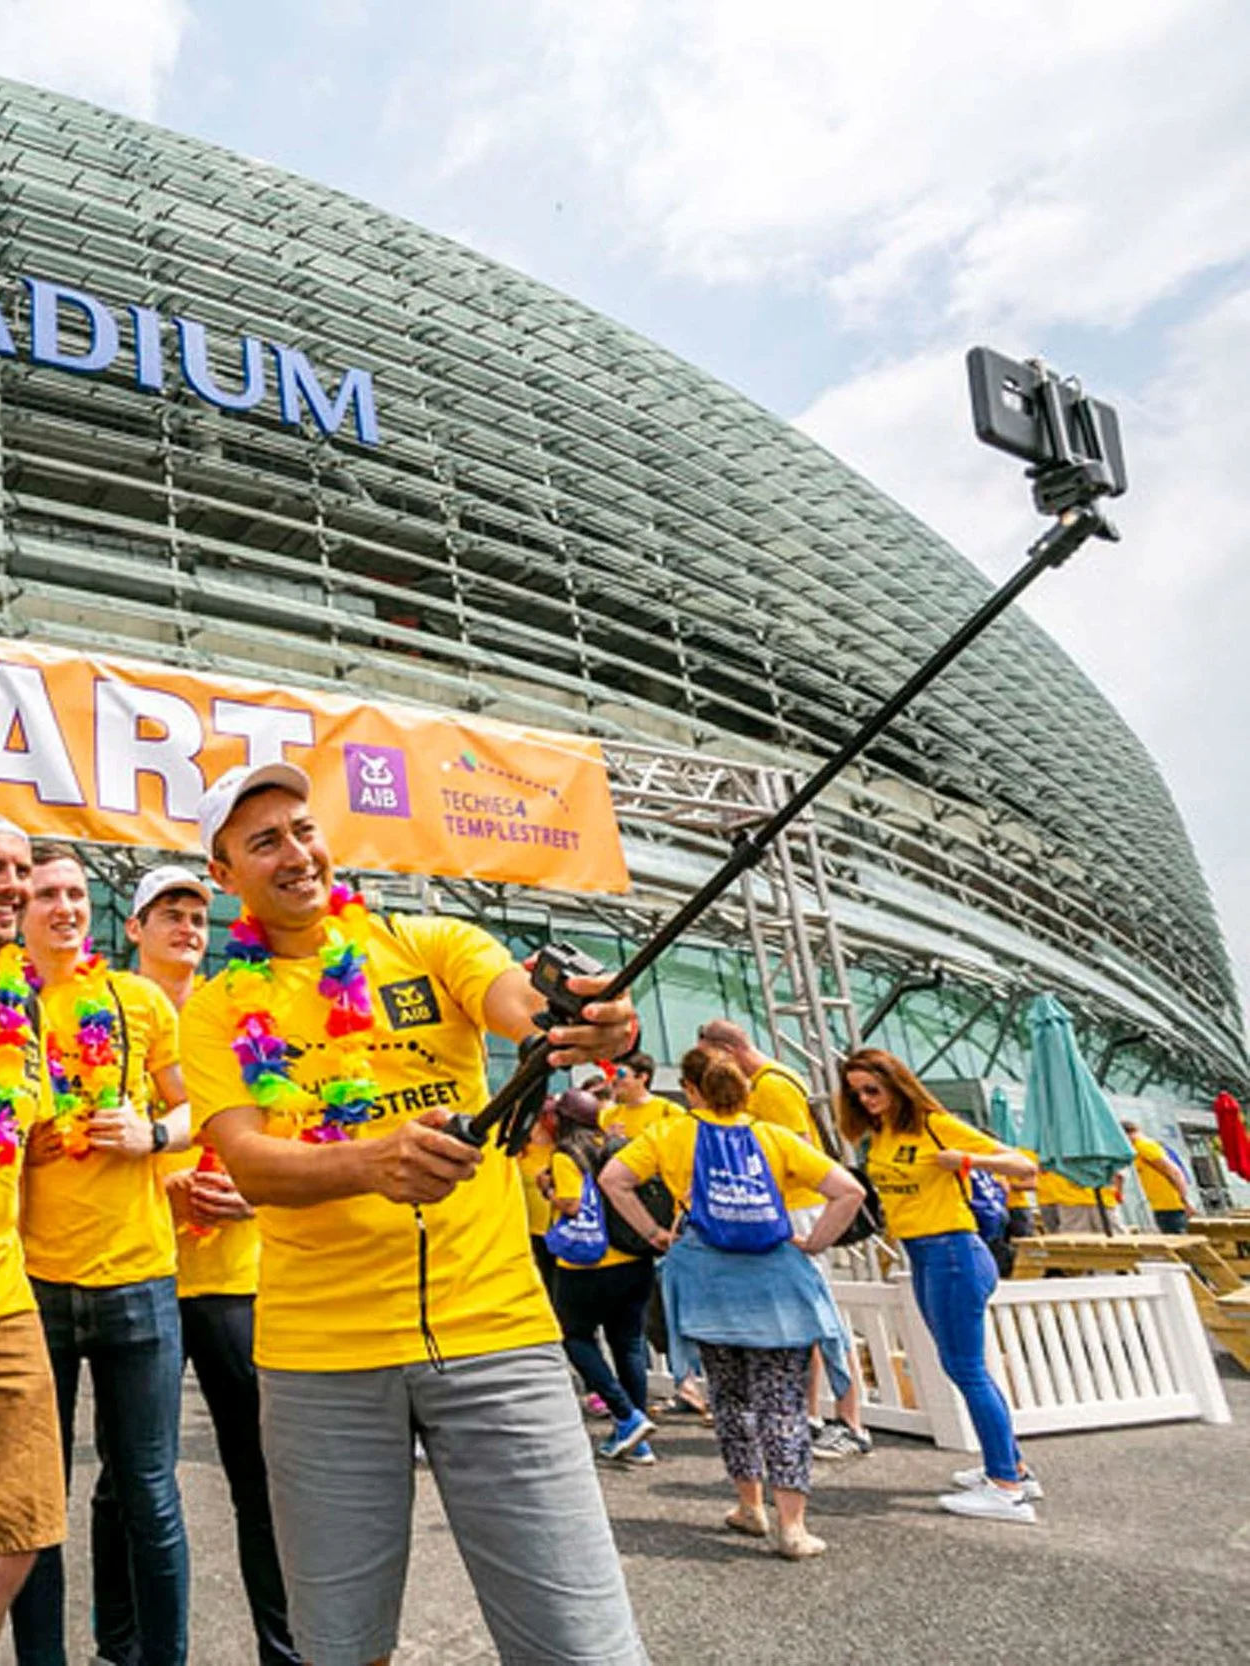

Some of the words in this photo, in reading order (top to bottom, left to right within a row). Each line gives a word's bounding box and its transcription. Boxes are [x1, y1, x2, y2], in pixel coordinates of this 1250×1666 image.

[359, 786, 399, 809] AIB
[440, 787, 527, 819] TECHIES4
[443, 813, 581, 851] TEMPLESTREET
[400, 1004, 432, 1024] AIB
[370, 1079, 461, 1121] STREET
